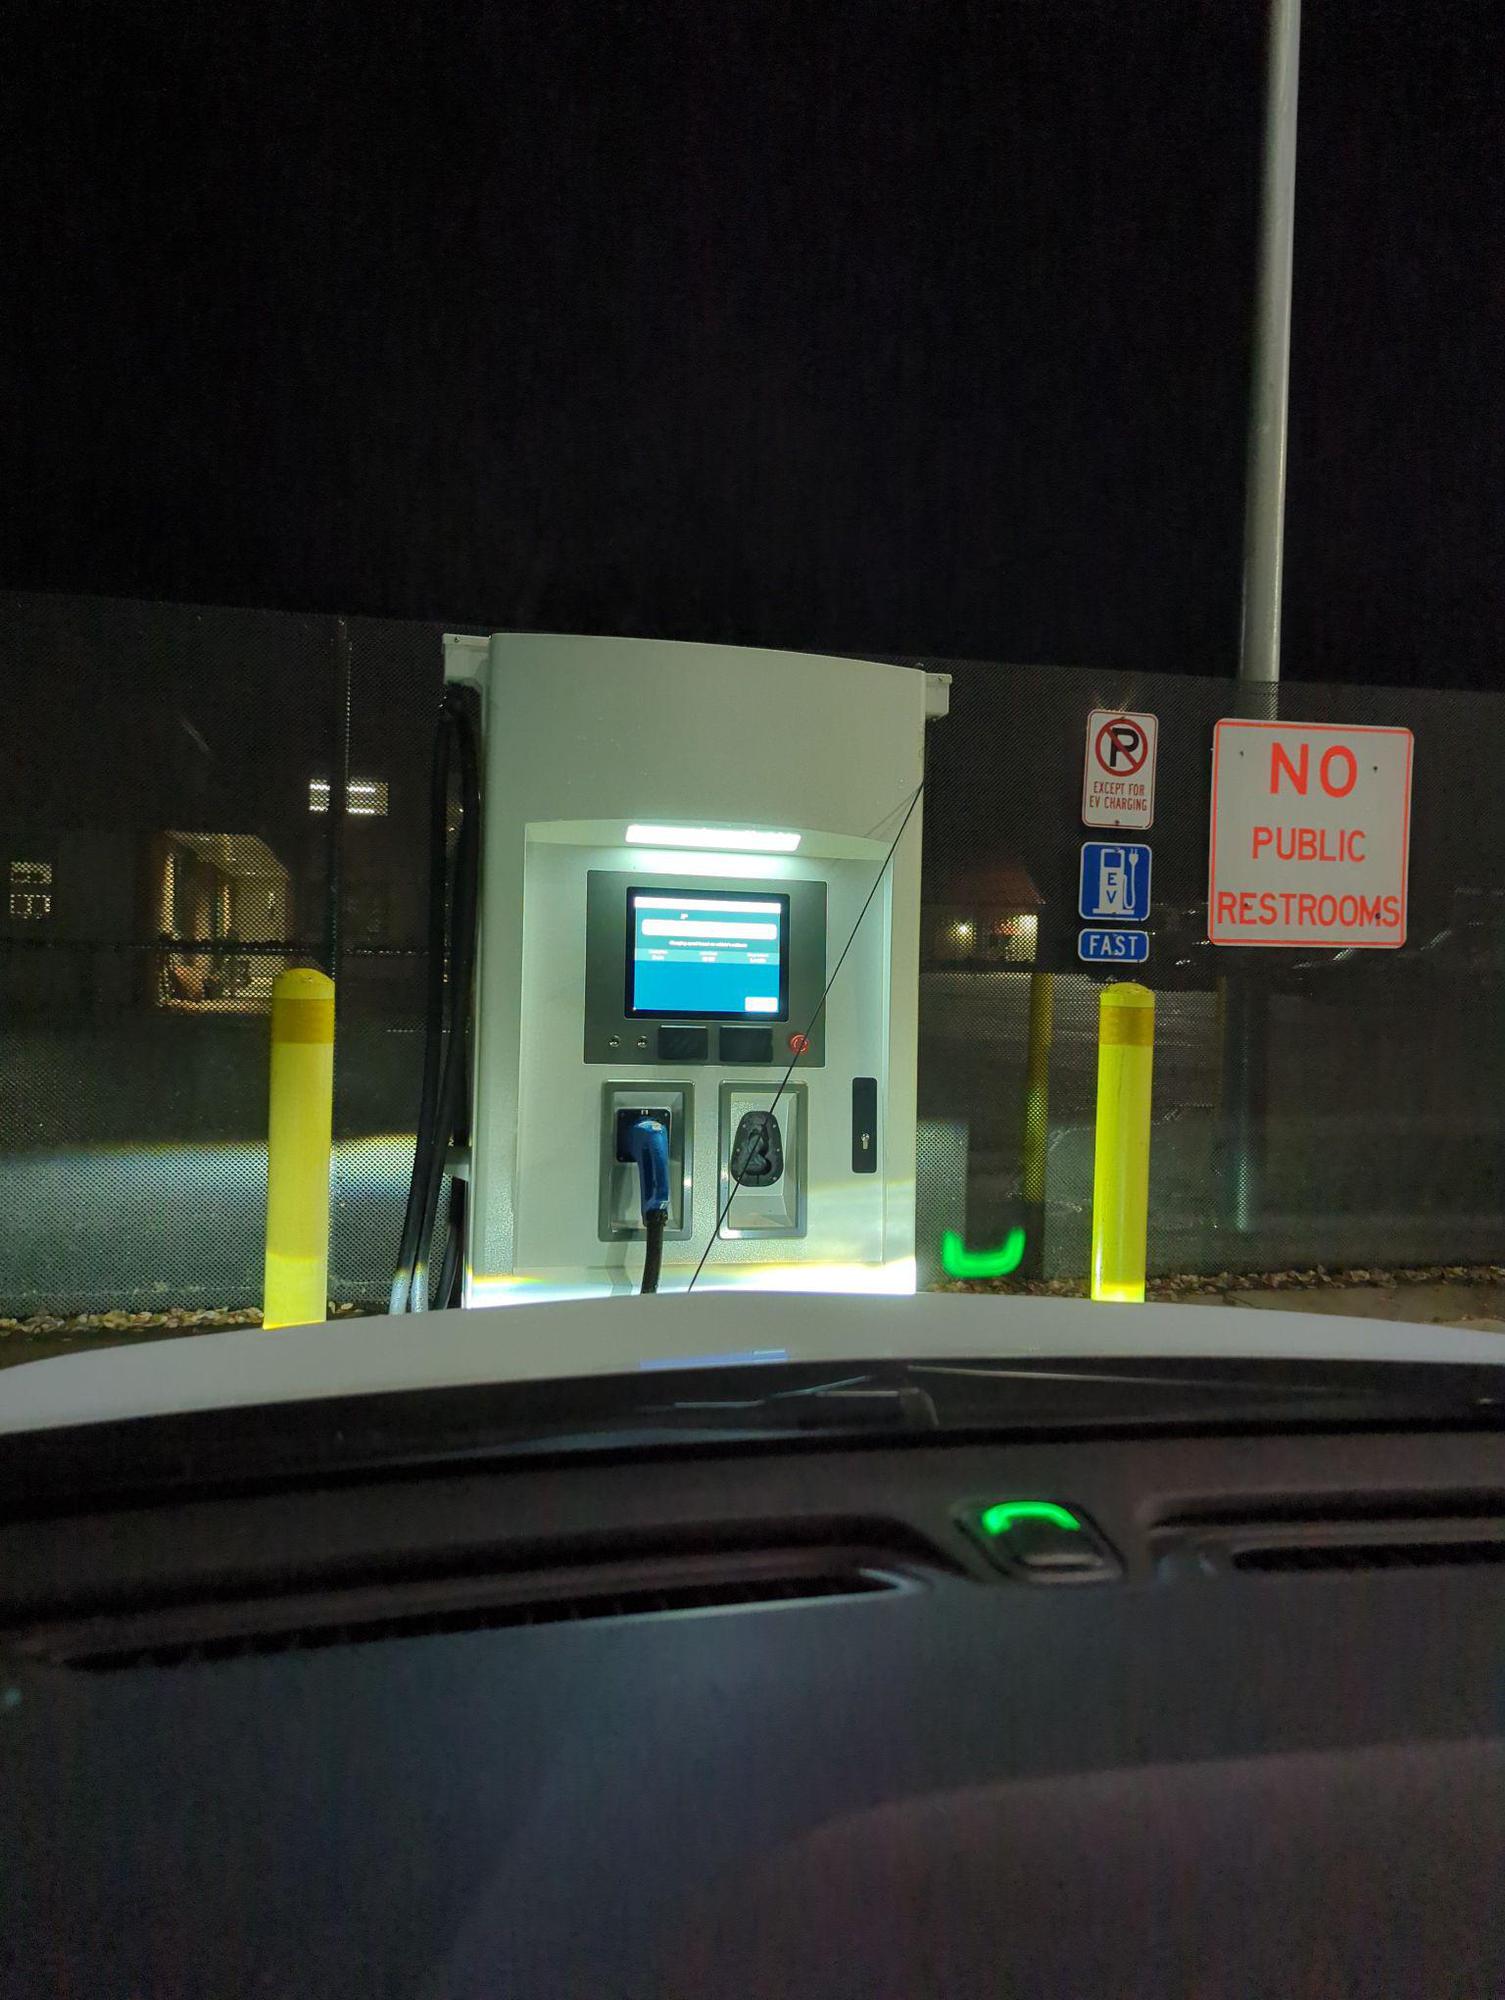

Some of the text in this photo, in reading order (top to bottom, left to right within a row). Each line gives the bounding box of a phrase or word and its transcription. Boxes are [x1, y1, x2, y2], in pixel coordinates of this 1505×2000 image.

[1270, 742, 1358, 798] NO
[1093, 781, 1145, 796] EXCEPT FOR
[1089, 796, 1147, 811] EV CHARGING
[1252, 827, 1366, 862] PUBLIC
[1217, 891, 1400, 928] RESTROOMS
[1089, 935, 1138, 957] FAST
